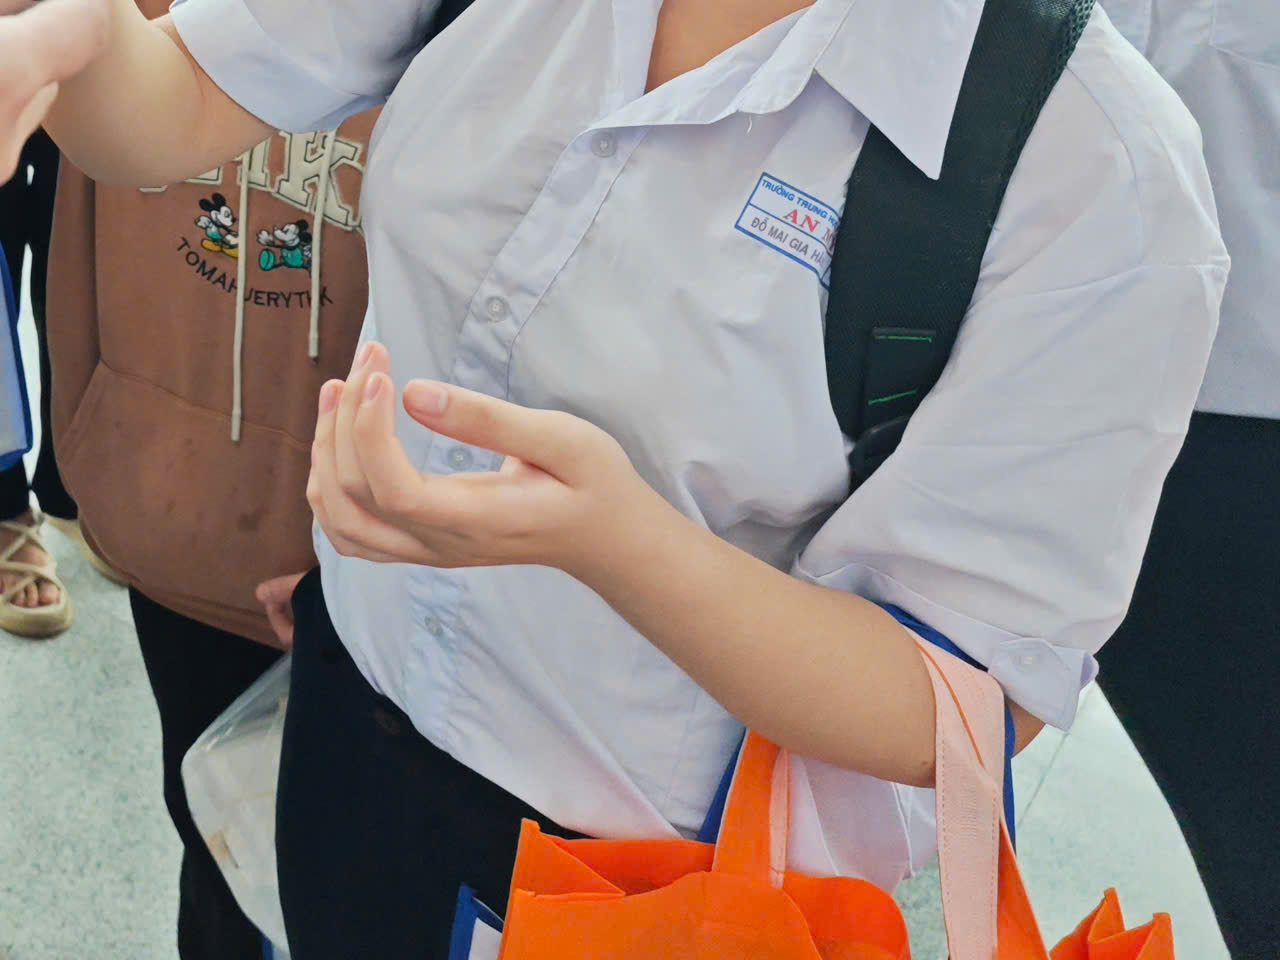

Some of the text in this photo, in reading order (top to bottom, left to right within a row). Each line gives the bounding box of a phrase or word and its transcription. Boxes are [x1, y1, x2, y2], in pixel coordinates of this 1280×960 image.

[761, 179, 796, 201] TRƯỜNG
[796, 196, 829, 219] TRUNG
[751, 216, 769, 232] ĐỖ
[768, 225, 789, 244] MAI
[789, 238, 809, 256] GIA
[783, 208, 821, 233] AN
